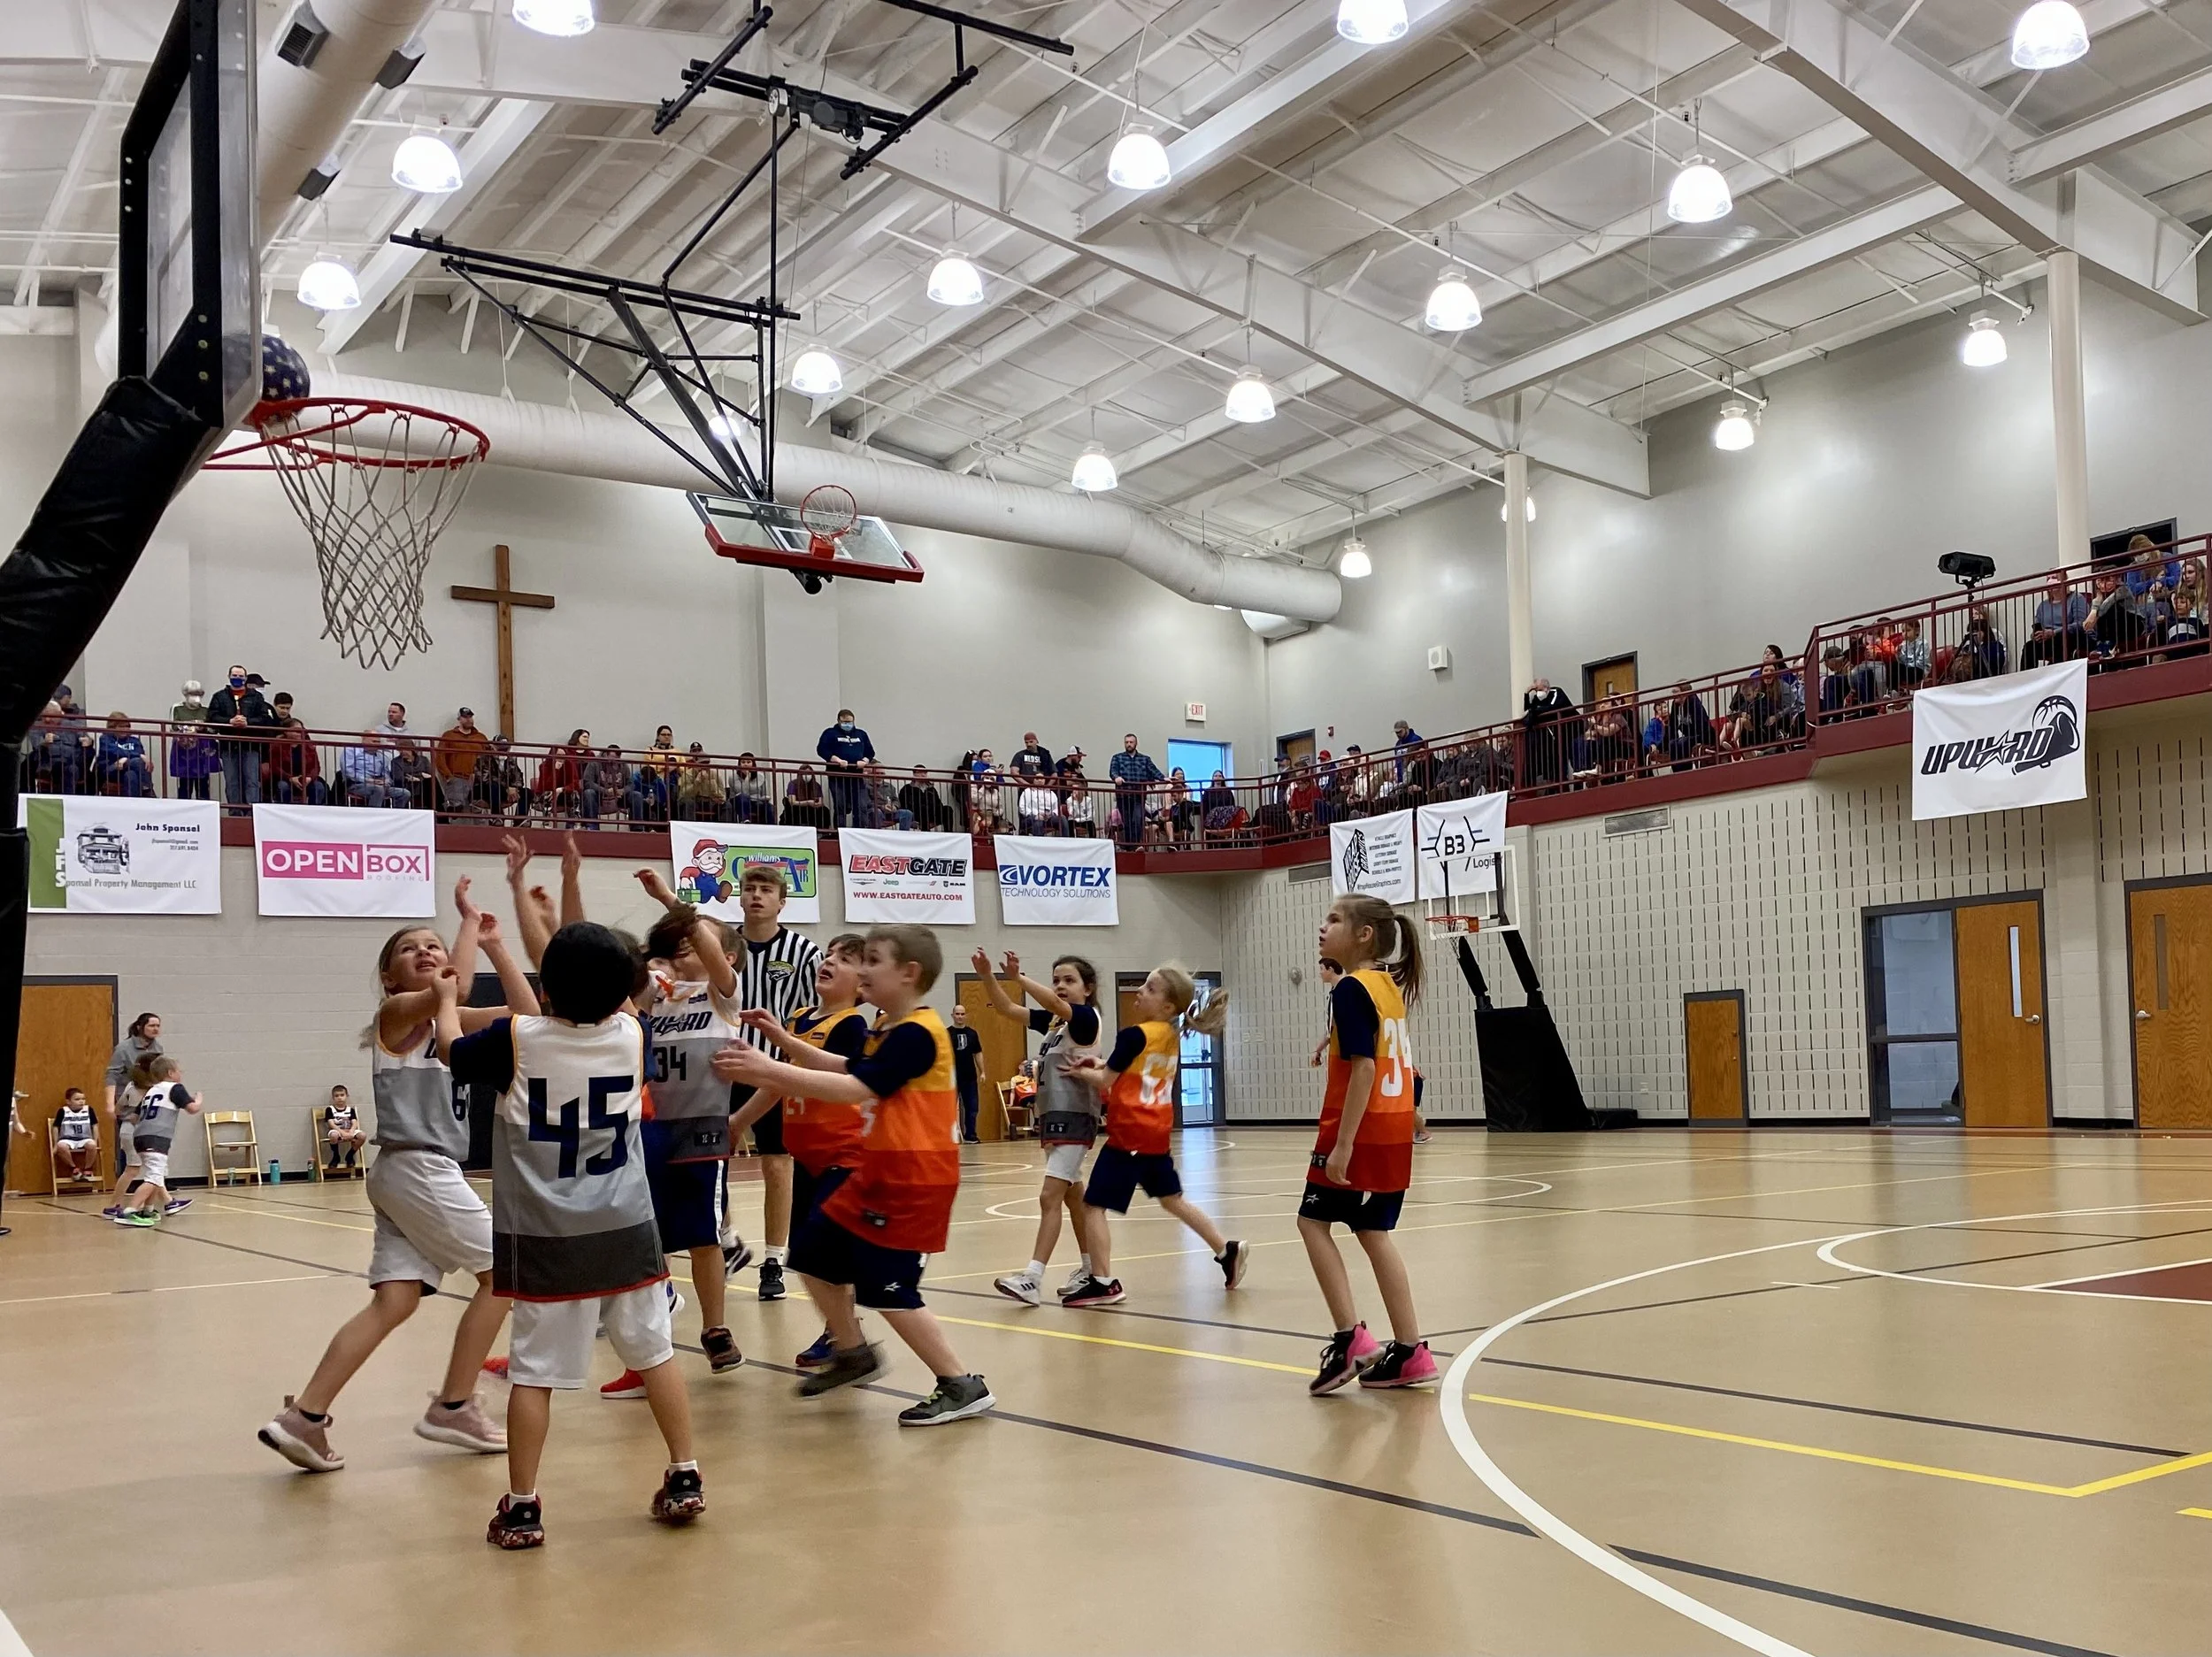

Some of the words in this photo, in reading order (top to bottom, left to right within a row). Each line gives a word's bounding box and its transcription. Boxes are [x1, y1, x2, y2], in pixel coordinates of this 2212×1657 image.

[1192, 704, 1203, 715] EXIT
[135, 823, 159, 832] John
[163, 824, 200, 833] Sponsel
[1445, 834, 1465, 855] B3
[266, 848, 358, 873] OPEN
[367, 855, 421, 873] BOX
[849, 855, 967, 877] EASTGATE
[95, 878, 128, 889] Property
[131, 879, 181, 890] Management
[183, 879, 196, 888] LLC
[1018, 864, 1111, 887] VORTEX
[853, 892, 963, 901] WWW.EASTGATEAUTO.COM
[1001, 887, 1061, 898] TECHNOLOGY
[1064, 888, 1111, 899] SOLUTIONS
[652, 1046, 687, 1083] 34
[528, 1075, 634, 1178] 45
